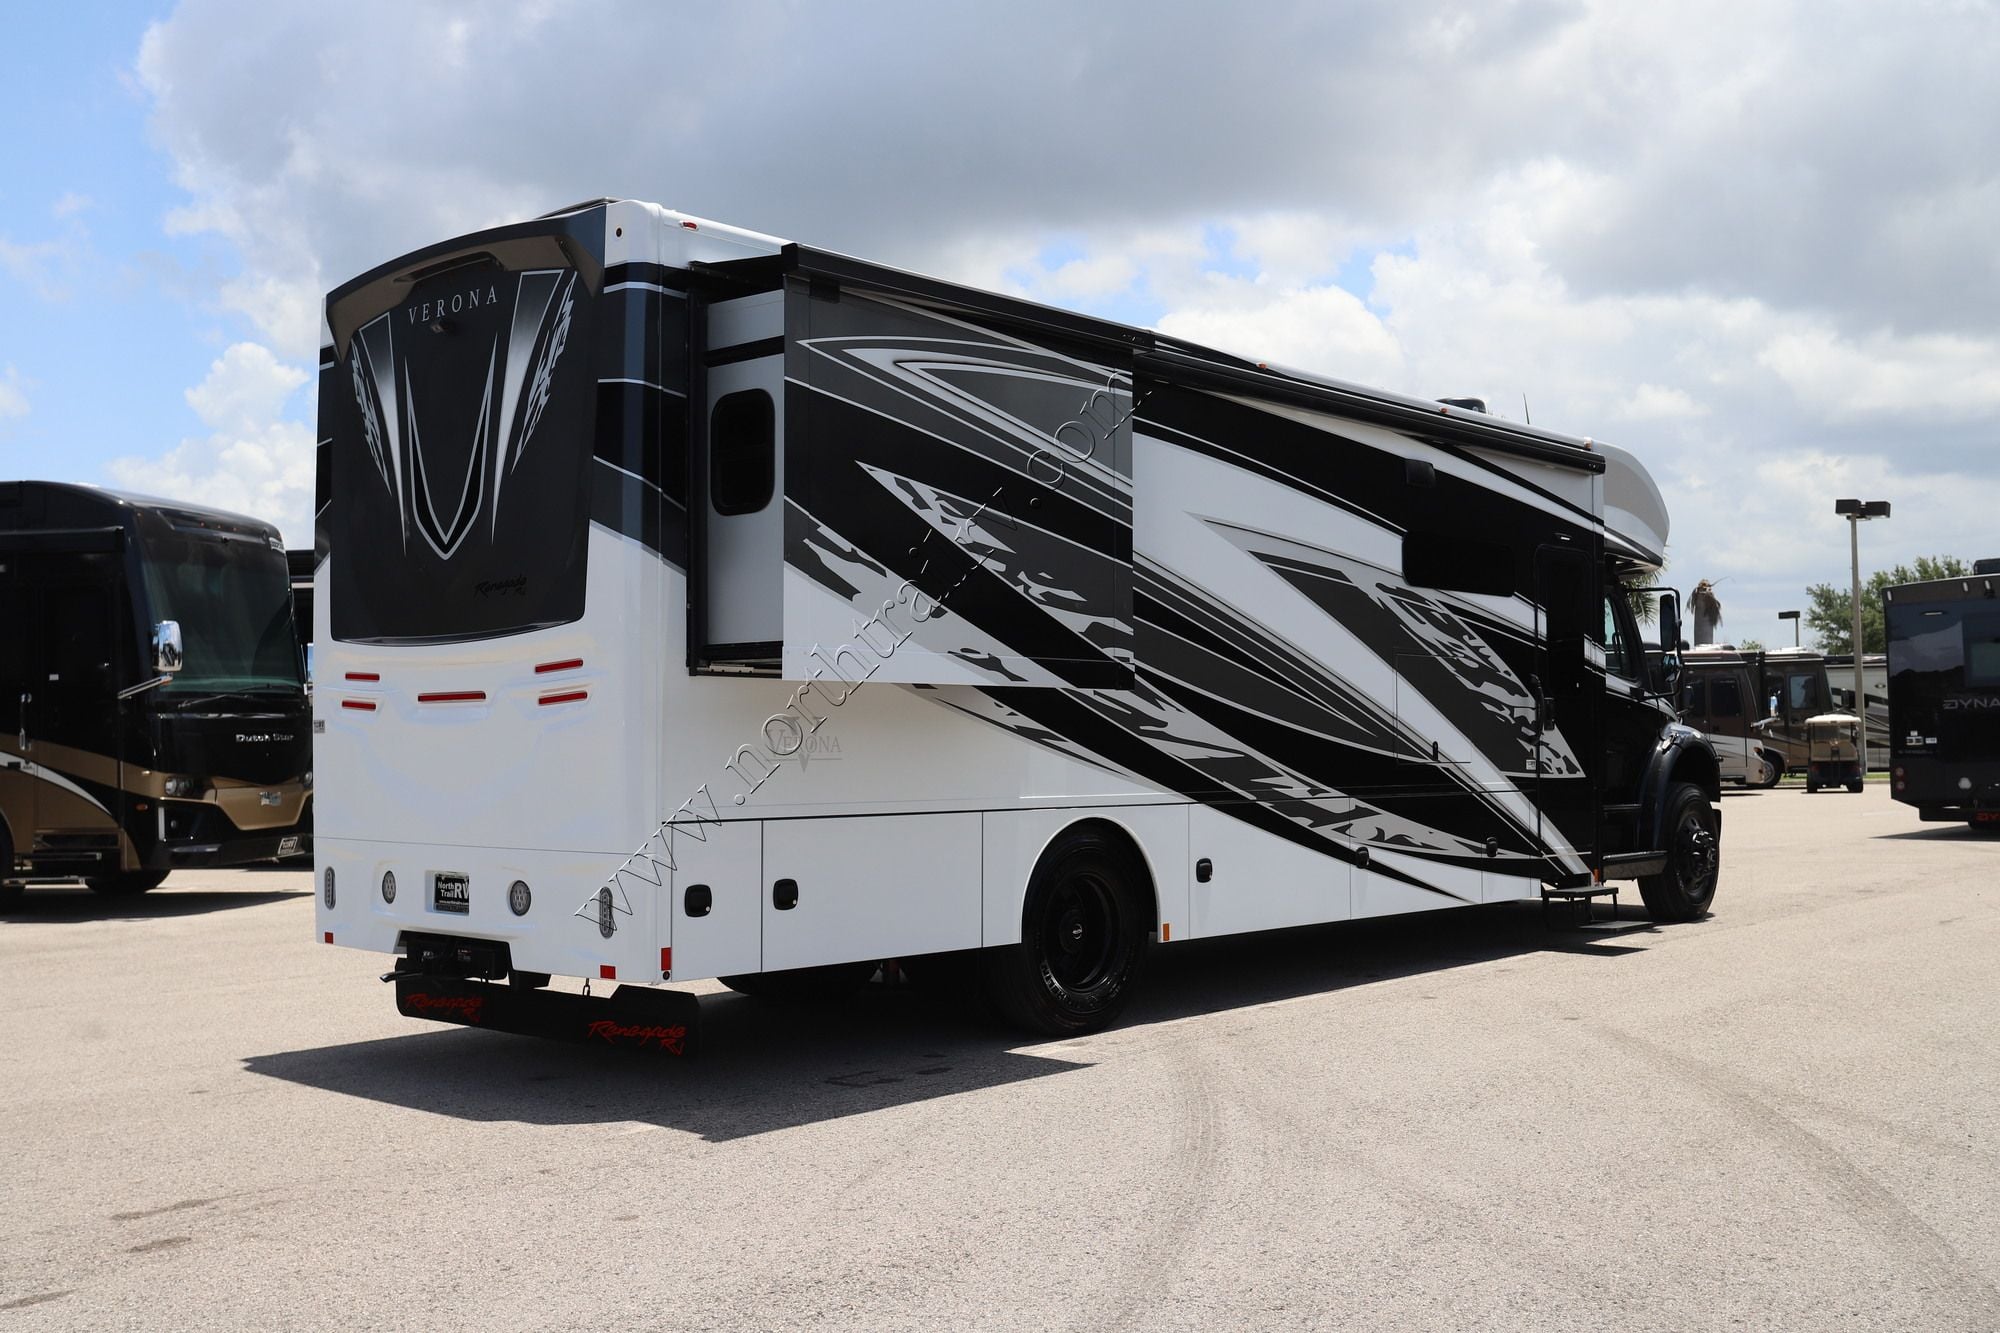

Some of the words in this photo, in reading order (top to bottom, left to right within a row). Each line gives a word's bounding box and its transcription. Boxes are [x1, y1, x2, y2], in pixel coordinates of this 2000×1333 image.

[408, 285, 497, 325] VERONA
[235, 733, 270, 742] Dutch
[437, 881, 455, 890] North
[454, 882, 469, 899] RV
[405, 993, 483, 1014] Renegade
[587, 1020, 687, 1046] Renegade
[660, 1037, 684, 1056] RV
